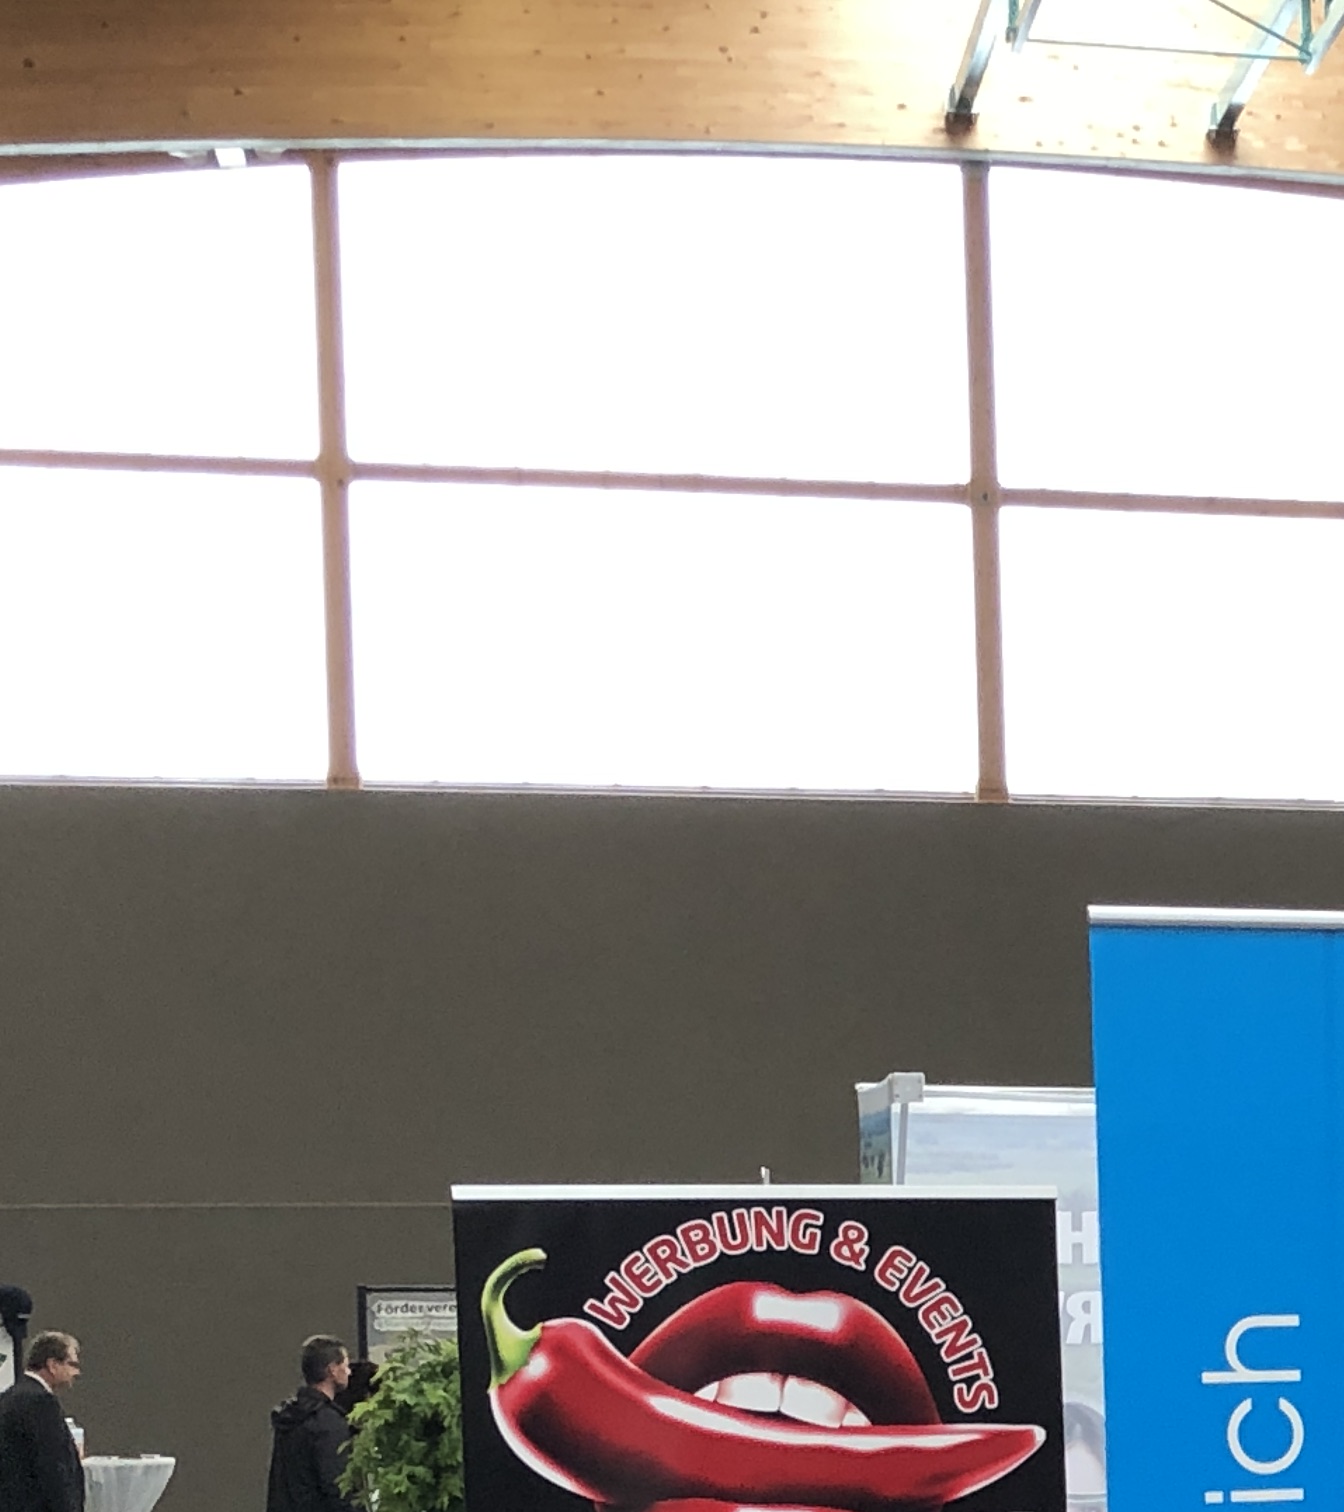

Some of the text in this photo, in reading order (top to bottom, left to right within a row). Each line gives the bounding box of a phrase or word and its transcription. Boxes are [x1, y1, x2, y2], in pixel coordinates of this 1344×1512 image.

[584, 1207, 824, 1330] WERBUNG
[830, 1220, 871, 1270] &
[874, 1246, 998, 1413] EVENTS
